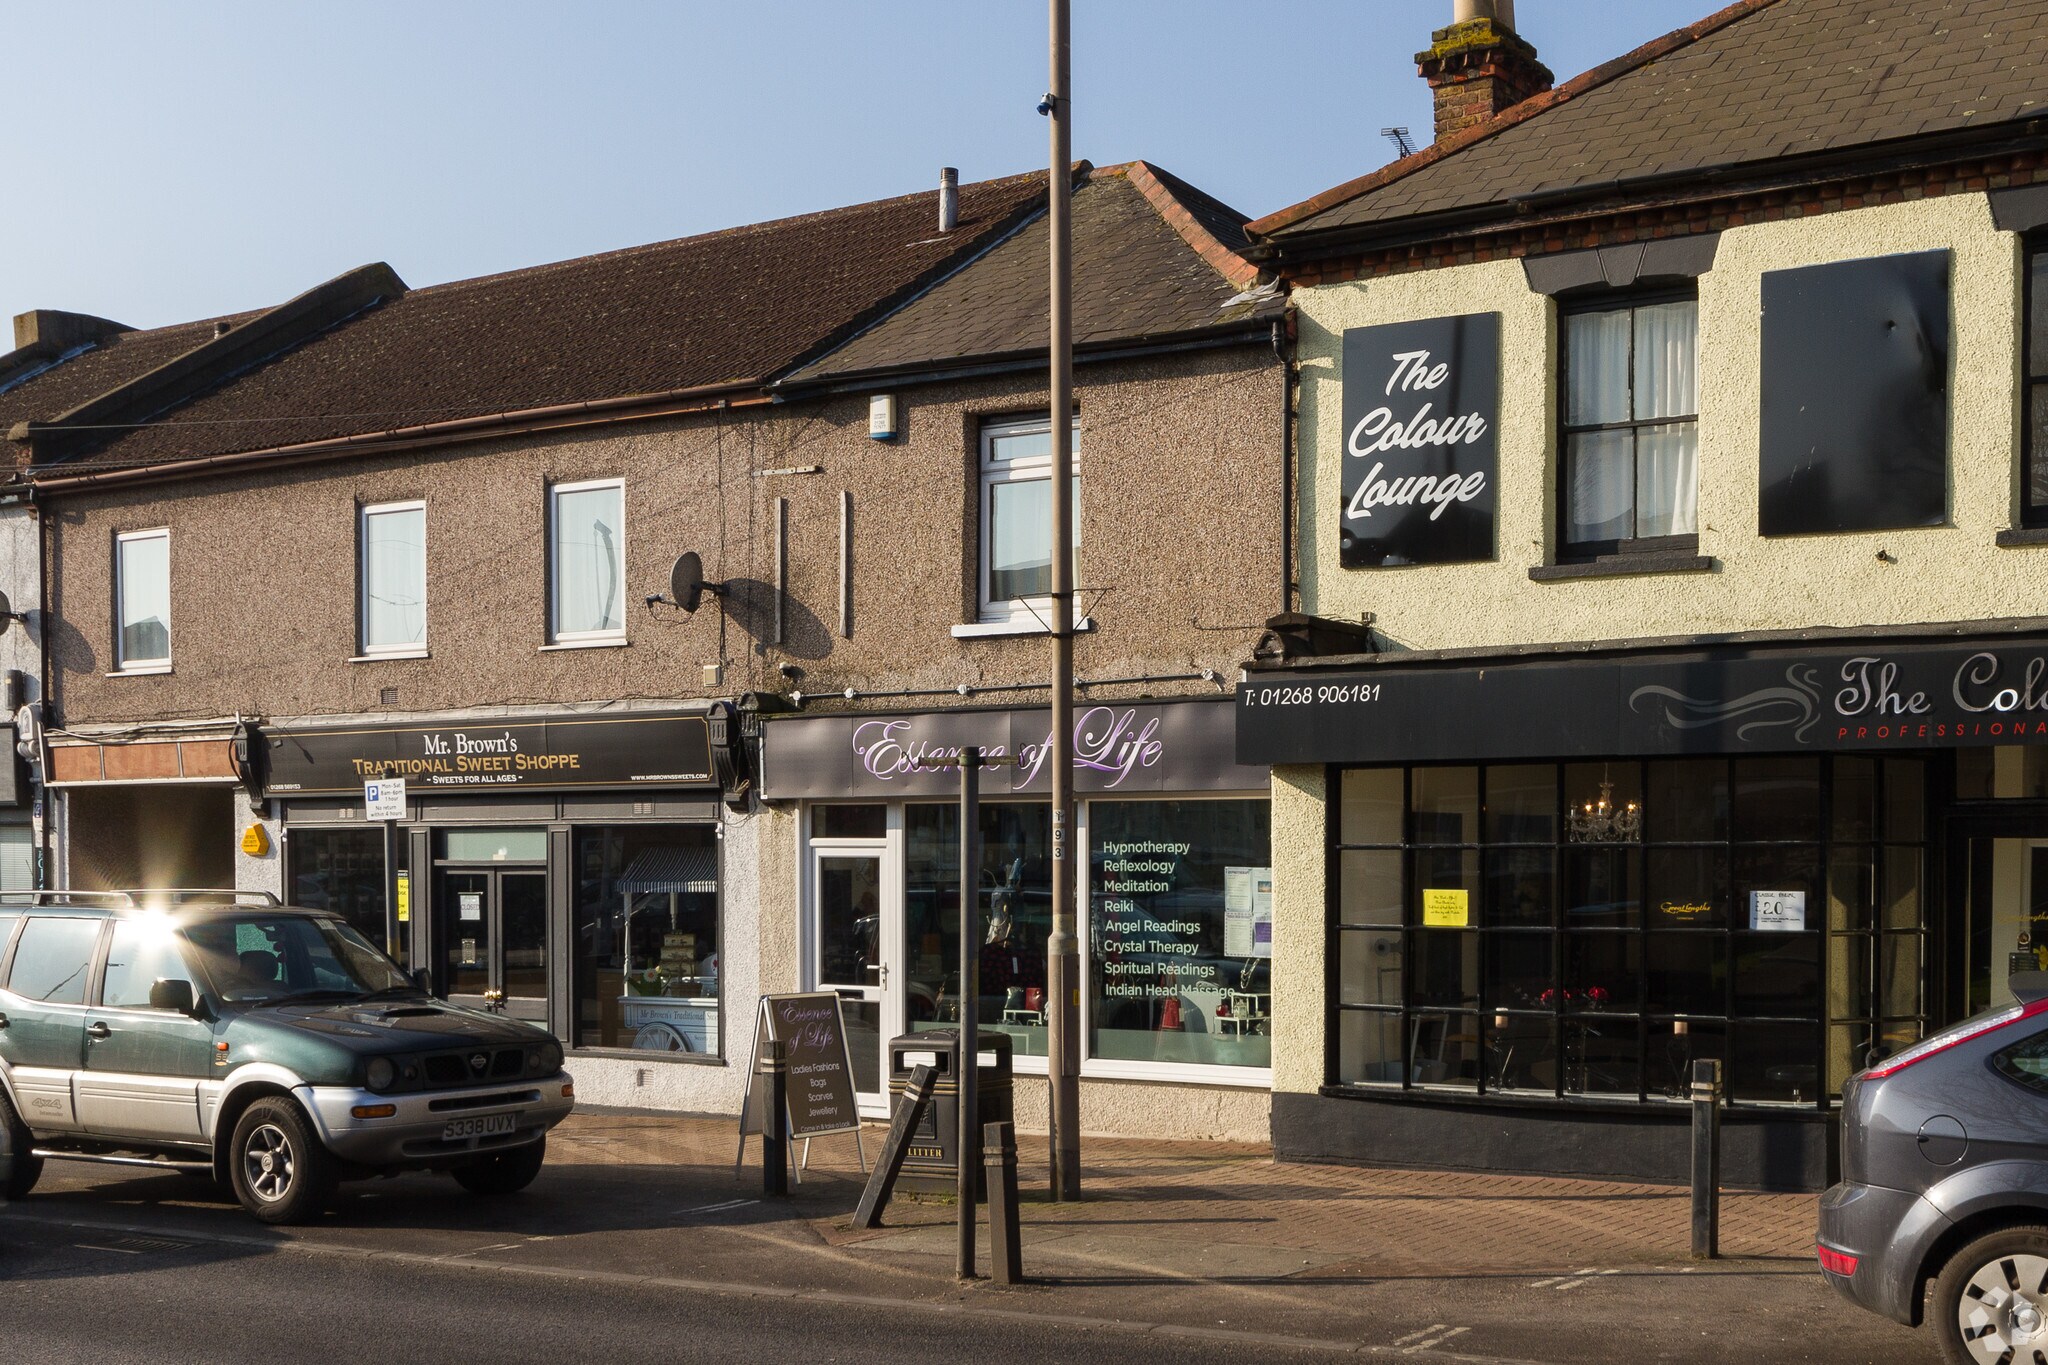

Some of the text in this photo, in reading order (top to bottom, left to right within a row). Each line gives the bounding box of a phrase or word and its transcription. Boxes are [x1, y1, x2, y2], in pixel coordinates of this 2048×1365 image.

[1385, 349, 1449, 396] The
[1348, 402, 1487, 457] Colour
[1347, 462, 1486, 521] Lounge
[1834, 656, 1931, 716] The
[1245, 684, 1380, 706] T: 01268 906181
[423, 731, 518, 755] Mr. Brown's
[1012, 730, 1054, 790] of
[1073, 706, 1163, 789] Life
[352, 753, 581, 775] TRADITIONAL SWEET SHOPPE
[432, 774, 517, 784] SWEETS FOR ALL AGES
[1103, 841, 1190, 856] Hypnotherapy
[1103, 859, 1175, 874] Reflexology
[1104, 880, 1169, 892] Meditation
[1104, 900, 1134, 912] Reiki
[1105, 920, 1200, 934] Angel Readings
[1104, 940, 1199, 955] Crystal Therapy
[1104, 962, 1215, 976] Spiritual Readings
[1105, 984, 1142, 996] Indian
[1145, 984, 1178, 996] Head
[778, 1000, 833, 1024] Essence
[789, 1022, 834, 1056] of Life
[791, 1062, 840, 1075] Ladies Fashions
[810, 1078, 827, 1088] Bags
[808, 1092, 833, 1102] Scarves
[808, 1106, 838, 1117] Jewellery
[445, 1115, 513, 1137] S338 UVX
[908, 1147, 942, 1157] LITTER
